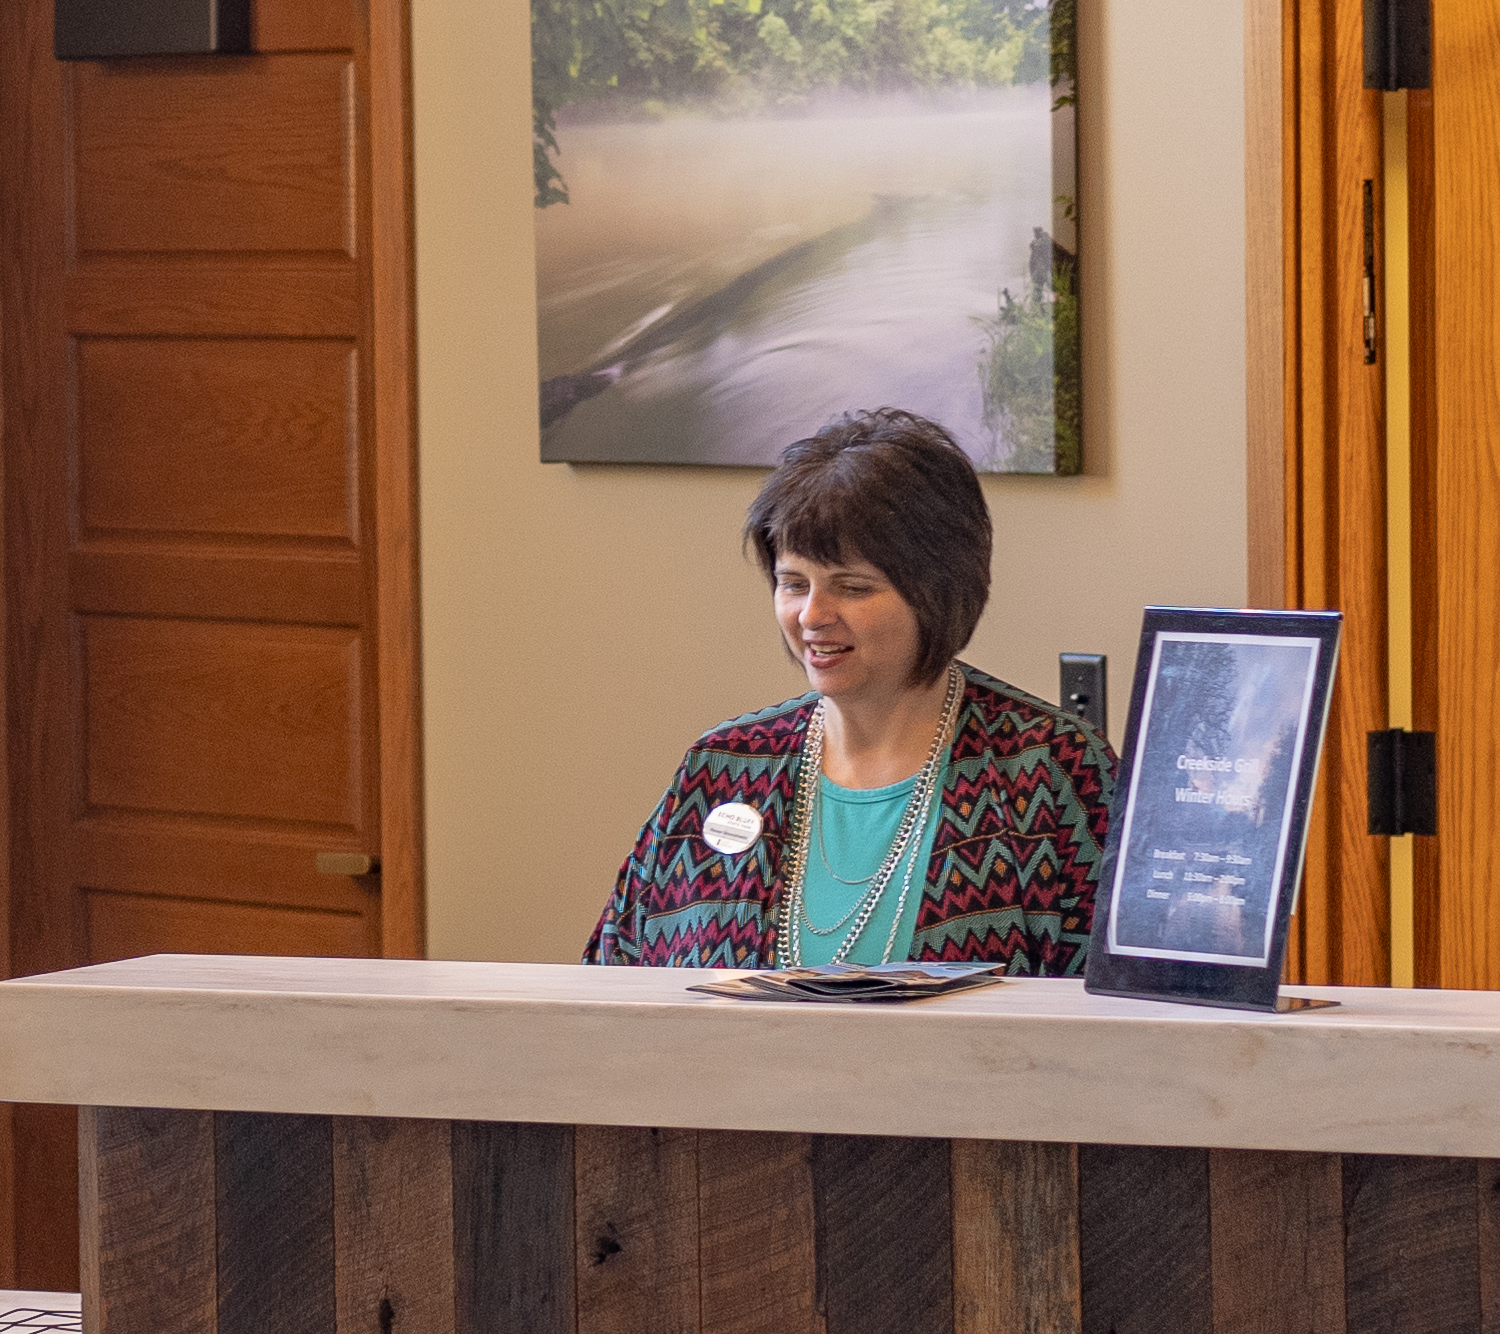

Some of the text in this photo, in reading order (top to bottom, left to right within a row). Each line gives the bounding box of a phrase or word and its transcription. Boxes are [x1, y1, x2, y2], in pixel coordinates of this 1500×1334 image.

[1176, 754, 1233, 773] Creekside
[1175, 787, 1253, 806] Winter Hours
[1153, 848, 1186, 861] Breakfast
[1153, 869, 1174, 880] Lunch
[1147, 889, 1170, 900] Dinner
